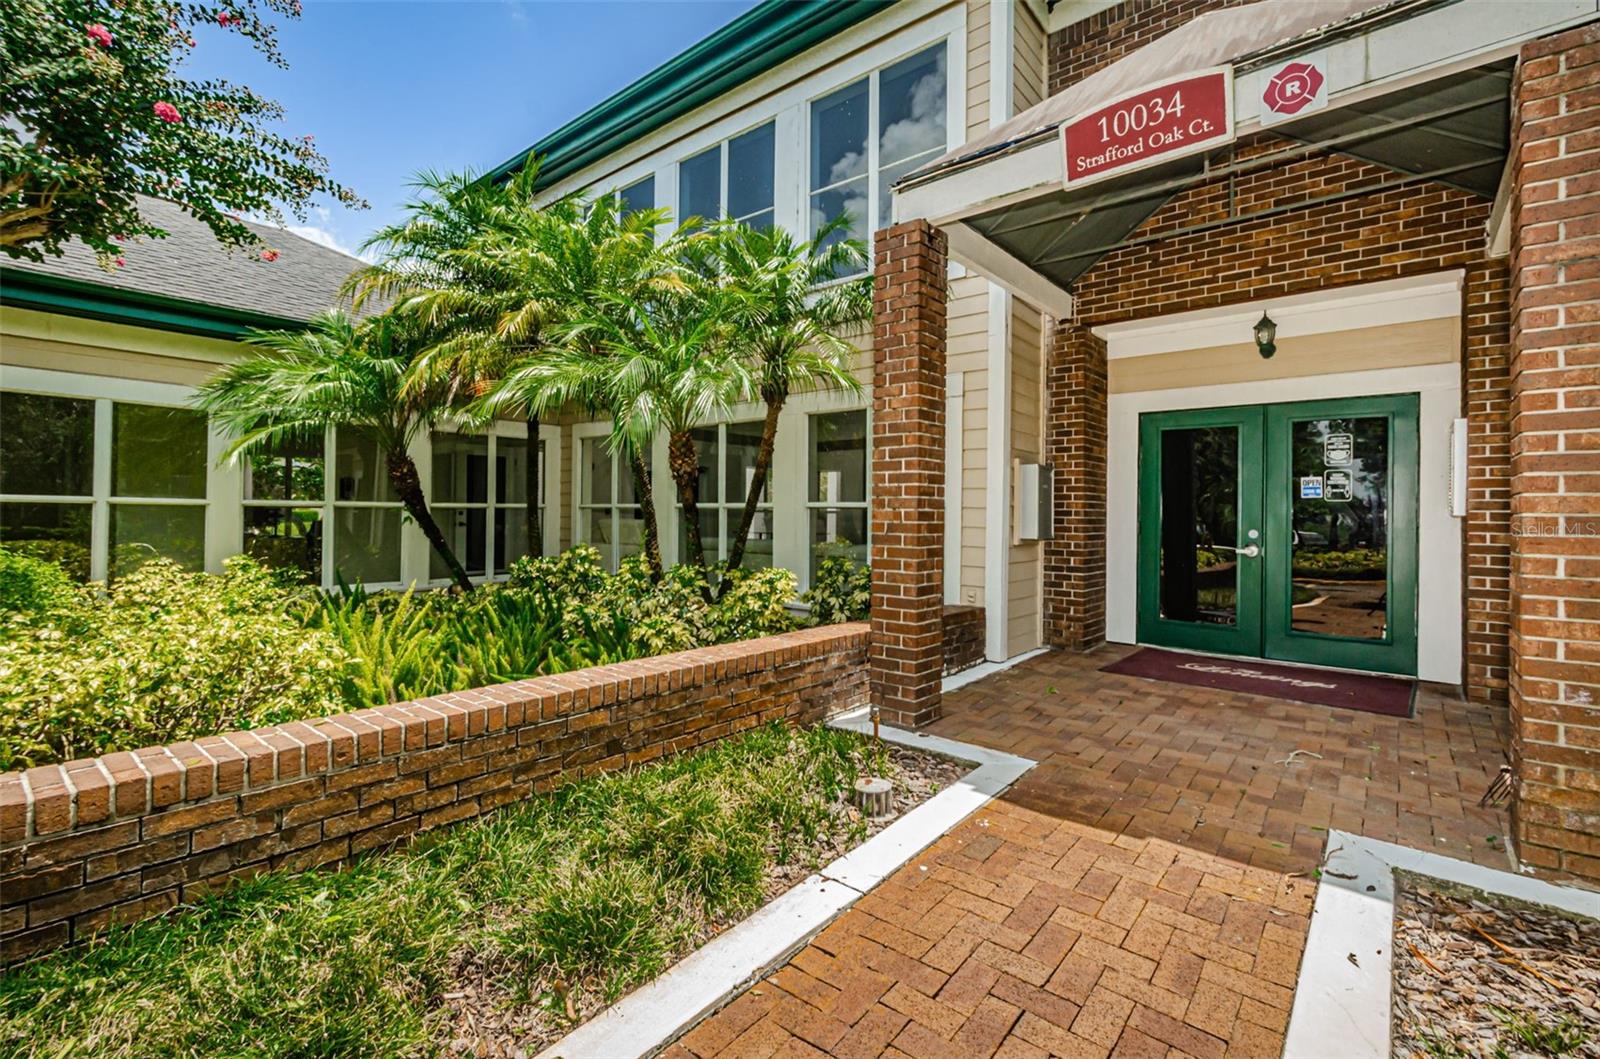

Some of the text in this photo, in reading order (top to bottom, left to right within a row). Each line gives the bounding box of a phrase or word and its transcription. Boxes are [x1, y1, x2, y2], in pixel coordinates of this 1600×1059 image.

[1285, 80, 1301, 97] R
[1097, 90, 1185, 142] 10034
[1076, 118, 1214, 172] Strafford Oak Ct.
